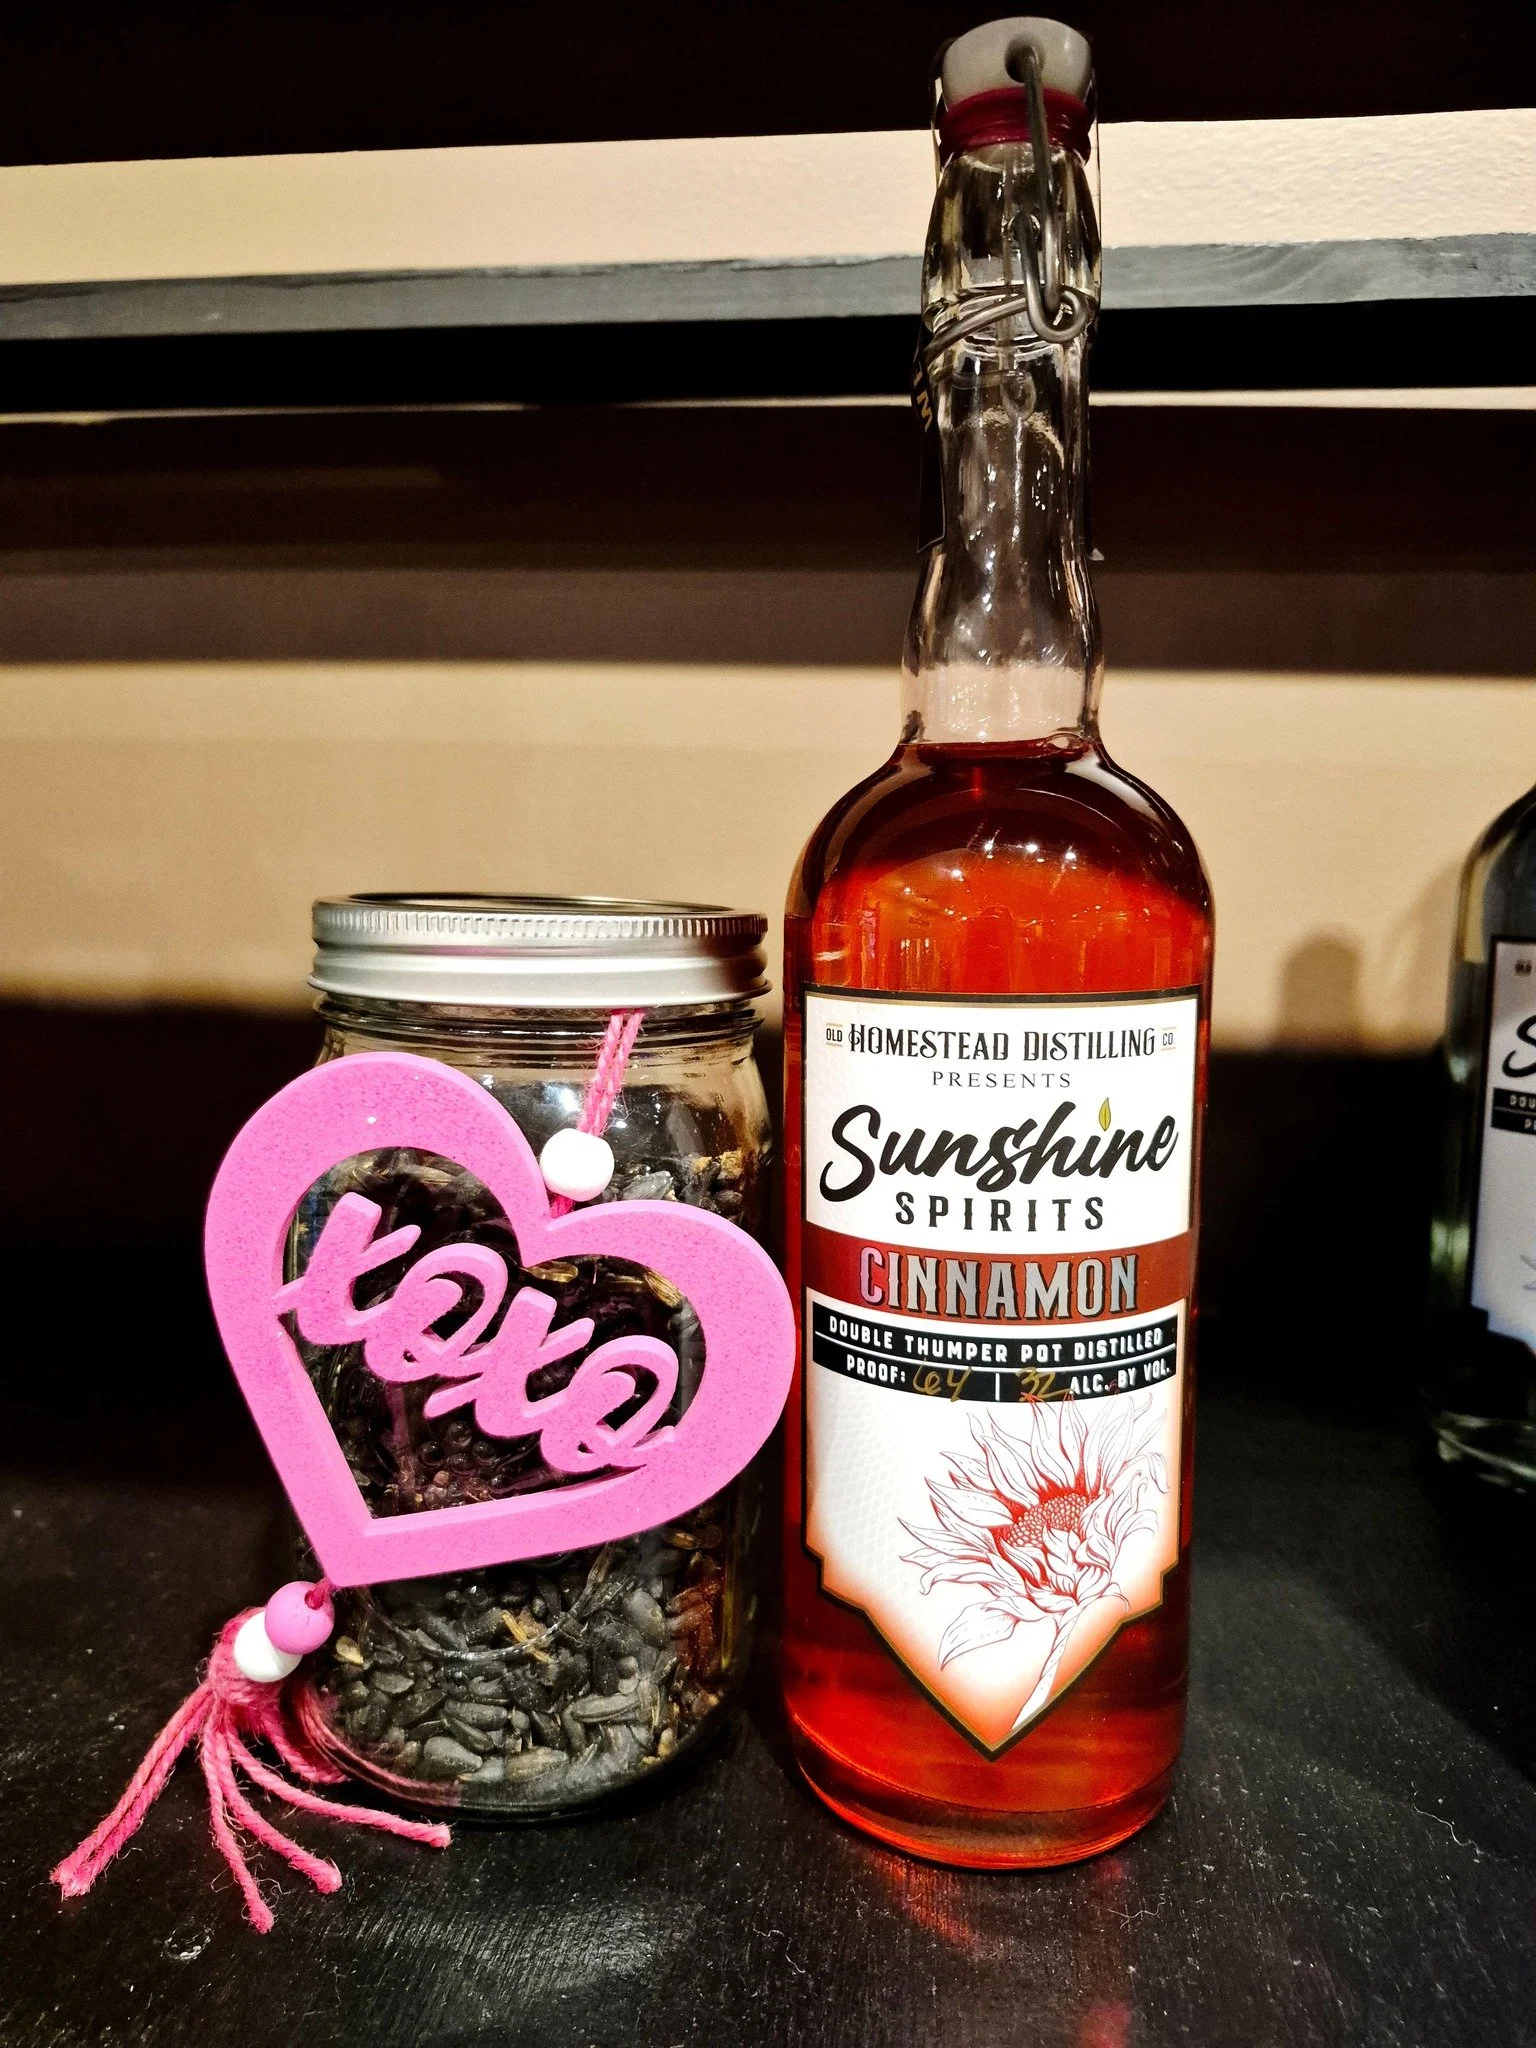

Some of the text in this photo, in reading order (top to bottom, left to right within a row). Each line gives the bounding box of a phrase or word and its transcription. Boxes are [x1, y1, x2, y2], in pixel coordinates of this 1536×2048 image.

[825, 1027, 843, 1043] OLD
[849, 1023, 1009, 1061] HOMESTEAD
[1023, 1028, 1155, 1061] DISTILLING
[932, 1071, 1072, 1089] PRESENTS
[819, 1097, 1179, 1203] Sunshine
[895, 1191, 1104, 1232] SPIRITS
[860, 1246, 1138, 1320] CINNAMON
[829, 1315, 1164, 1364] DOUBLE THUMPER POT DISTILLED
[846, 1357, 907, 1384] PROOF:
[1068, 1374, 1110, 1396] ALC.
[1117, 1368, 1136, 1389] BY
[1143, 1358, 1171, 1384] VOL.
